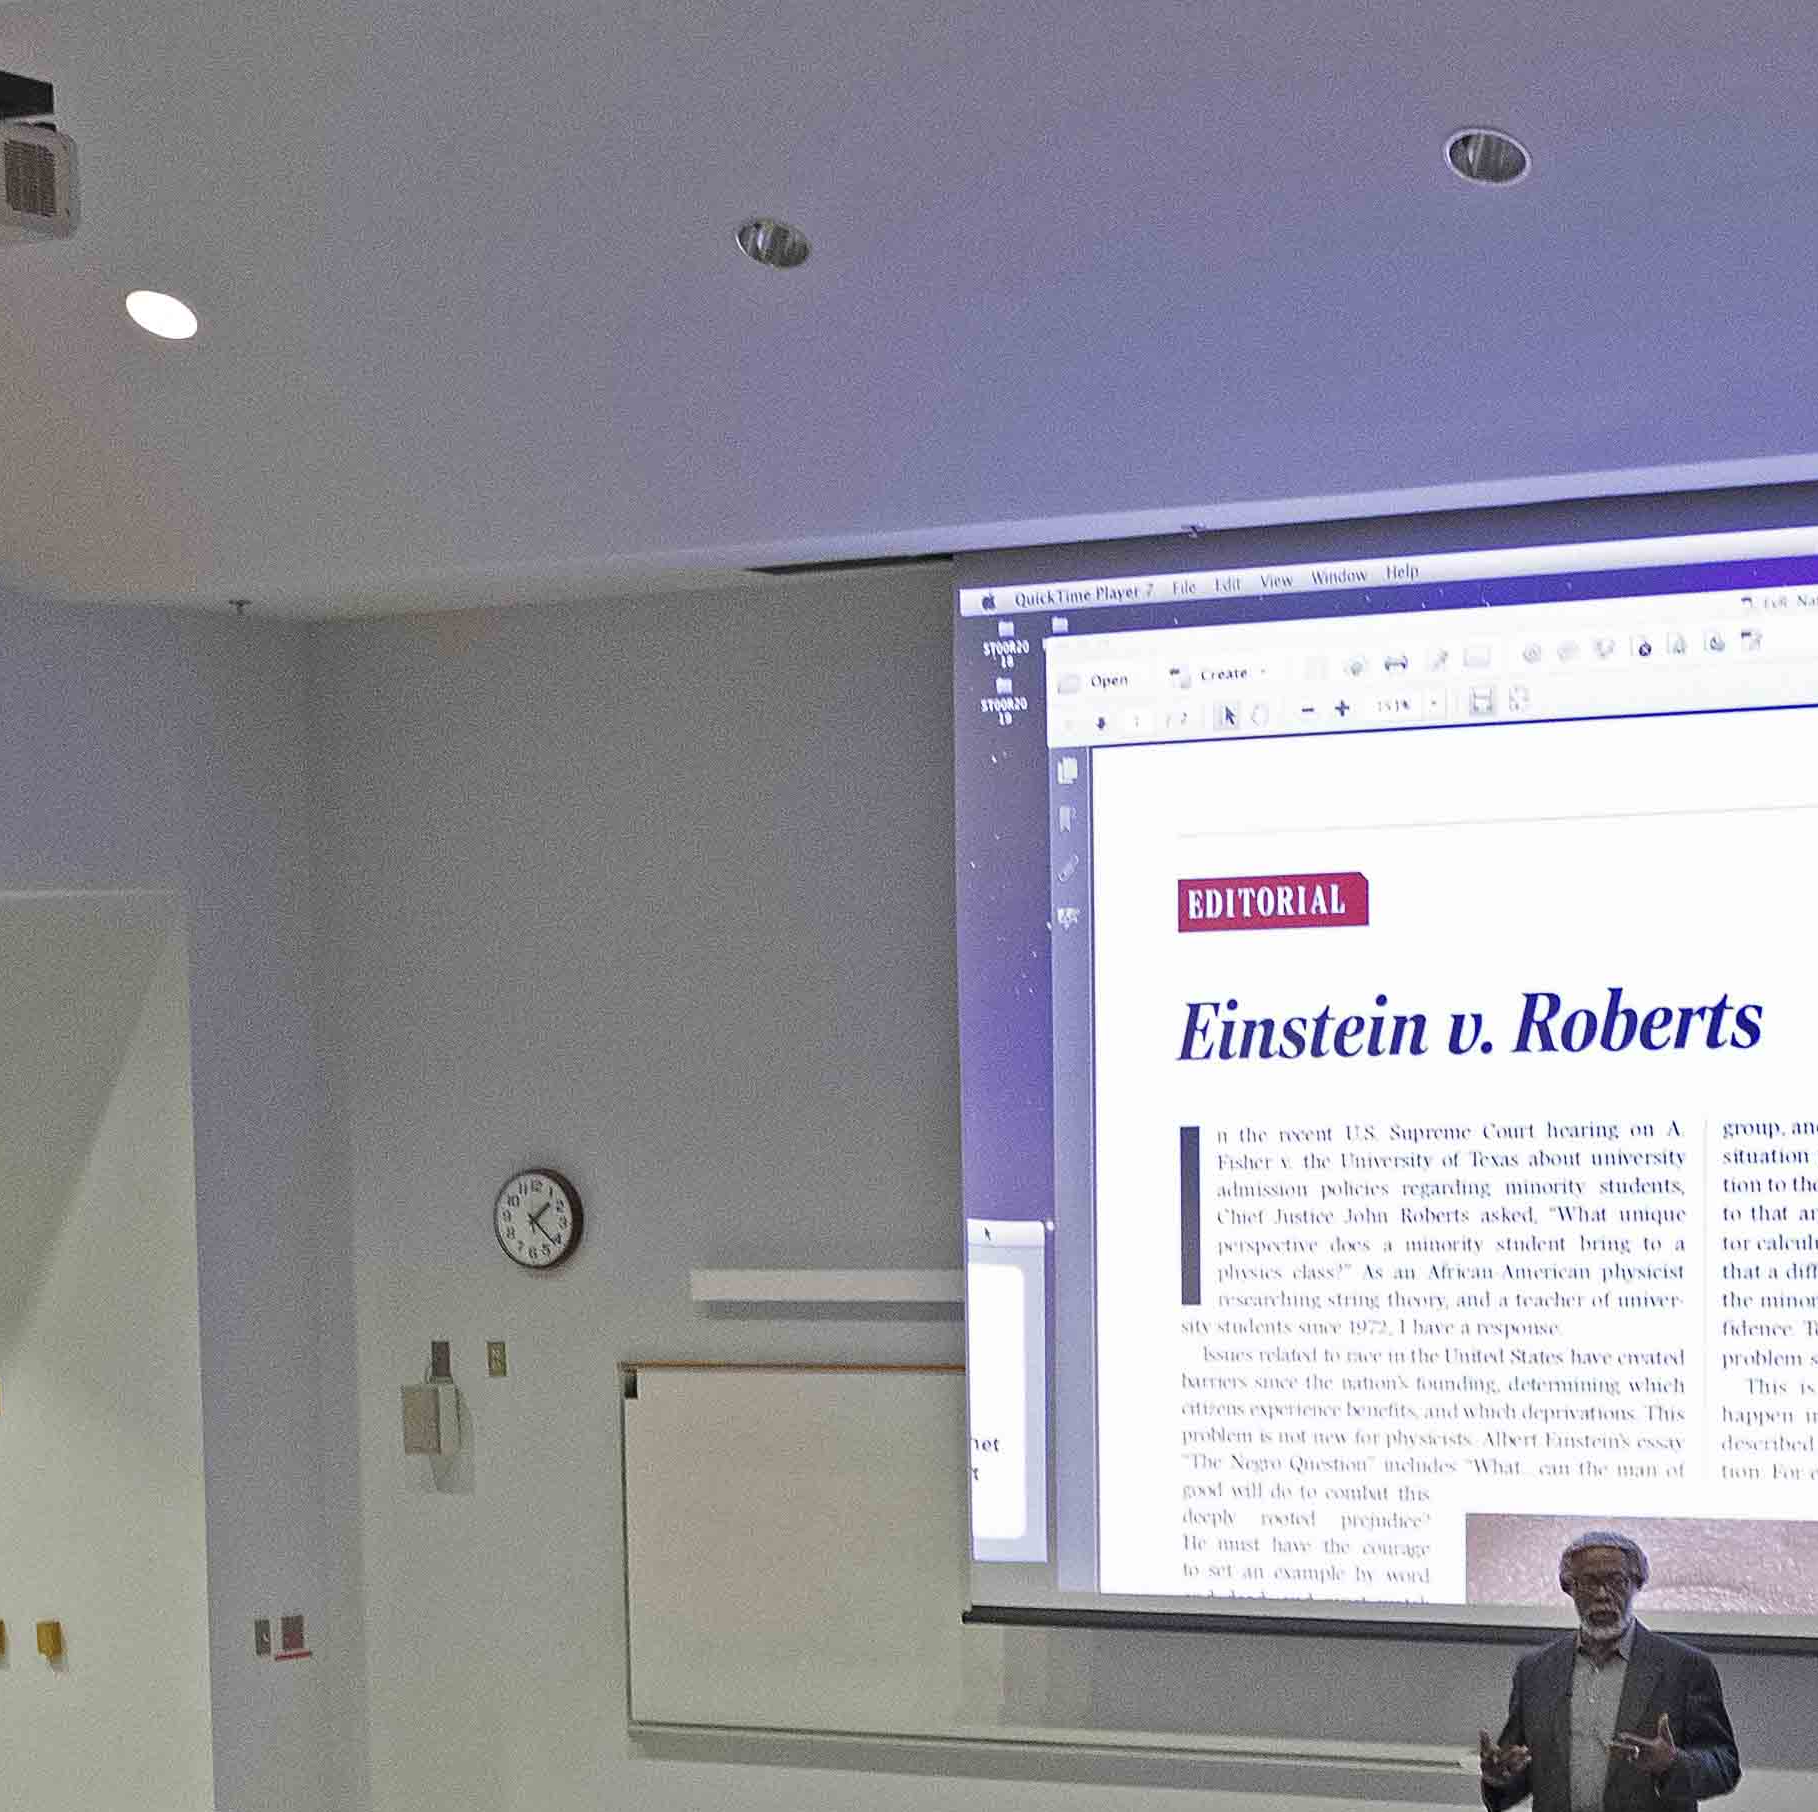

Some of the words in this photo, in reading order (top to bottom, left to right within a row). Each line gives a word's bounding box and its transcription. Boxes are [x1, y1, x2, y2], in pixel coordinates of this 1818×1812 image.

[1311, 569, 1368, 585] Window
[1386, 563, 1420, 581] Help
[1172, 579, 1196, 595] File
[1215, 576, 1242, 592] Edit
[1260, 574, 1293, 589] View
[1014, 589, 1092, 608] QuickTime
[1096, 584, 1140, 602] Player
[1091, 674, 1128, 689] Open
[1200, 667, 1248, 682] Create
[1187, 883, 1347, 921] EDITORIAL
[1175, 993, 1429, 1061] Einstein
[1447, 1011, 1493, 1055] v.
[1511, 986, 1764, 1053] Roberts
[1240, 1128, 1266, 1143] the
[1280, 1128, 1331, 1142] recent
[1390, 1125, 1471, 1144] Supreme
[1483, 1123, 1533, 1139] Court
[1547, 1121, 1619, 1140] hearing
[1630, 1124, 1653, 1136] on
[1723, 1123, 1785, 1139] group,
[1218, 1154, 1269, 1170] Fisher
[1304, 1153, 1330, 1168] the
[1341, 1152, 1429, 1168] University
[1442, 1153, 1458, 1168] of
[1469, 1152, 1518, 1167] Texas
[1529, 1150, 1579, 1167] about
[1592, 1150, 1685, 1168] university
[1723, 1149, 1809, 1164] situation
[1217, 1181, 1307, 1197] admission
[1322, 1180, 1389, 1200] policies
[1403, 1179, 1491, 1199] regarding
[1506, 1180, 1581, 1195] minority
[1600, 1177, 1685, 1195] students,
[1723, 1179, 1761, 1192] tion
[1768, 1178, 1786, 1192] to
[1218, 1209, 1262, 1224] Chief
[1275, 1208, 1333, 1224] Justice
[1345, 1208, 1387, 1224] John
[1402, 1208, 1469, 1224] Roberts
[1481, 1206, 1537, 1224] asked,
[1620, 1209, 1685, 1226] unique
[1723, 1208, 1741, 1221] to
[1751, 1205, 1787, 1222] that
[1219, 1240, 1317, 1256] perspective
[1330, 1236, 1370, 1252] does
[1384, 1241, 1392, 1252] a
[1406, 1238, 1483, 1252] minority
[1497, 1234, 1565, 1252] student
[1581, 1235, 1631, 1255] bring
[1643, 1237, 1661, 1251] to
[1675, 1240, 1685, 1251] a
[1217, 1263, 1281, 1289] physics
[1365, 1264, 1383, 1280] As
[1394, 1268, 1415, 1280] an
[1602, 1263, 1683, 1283] physicist
